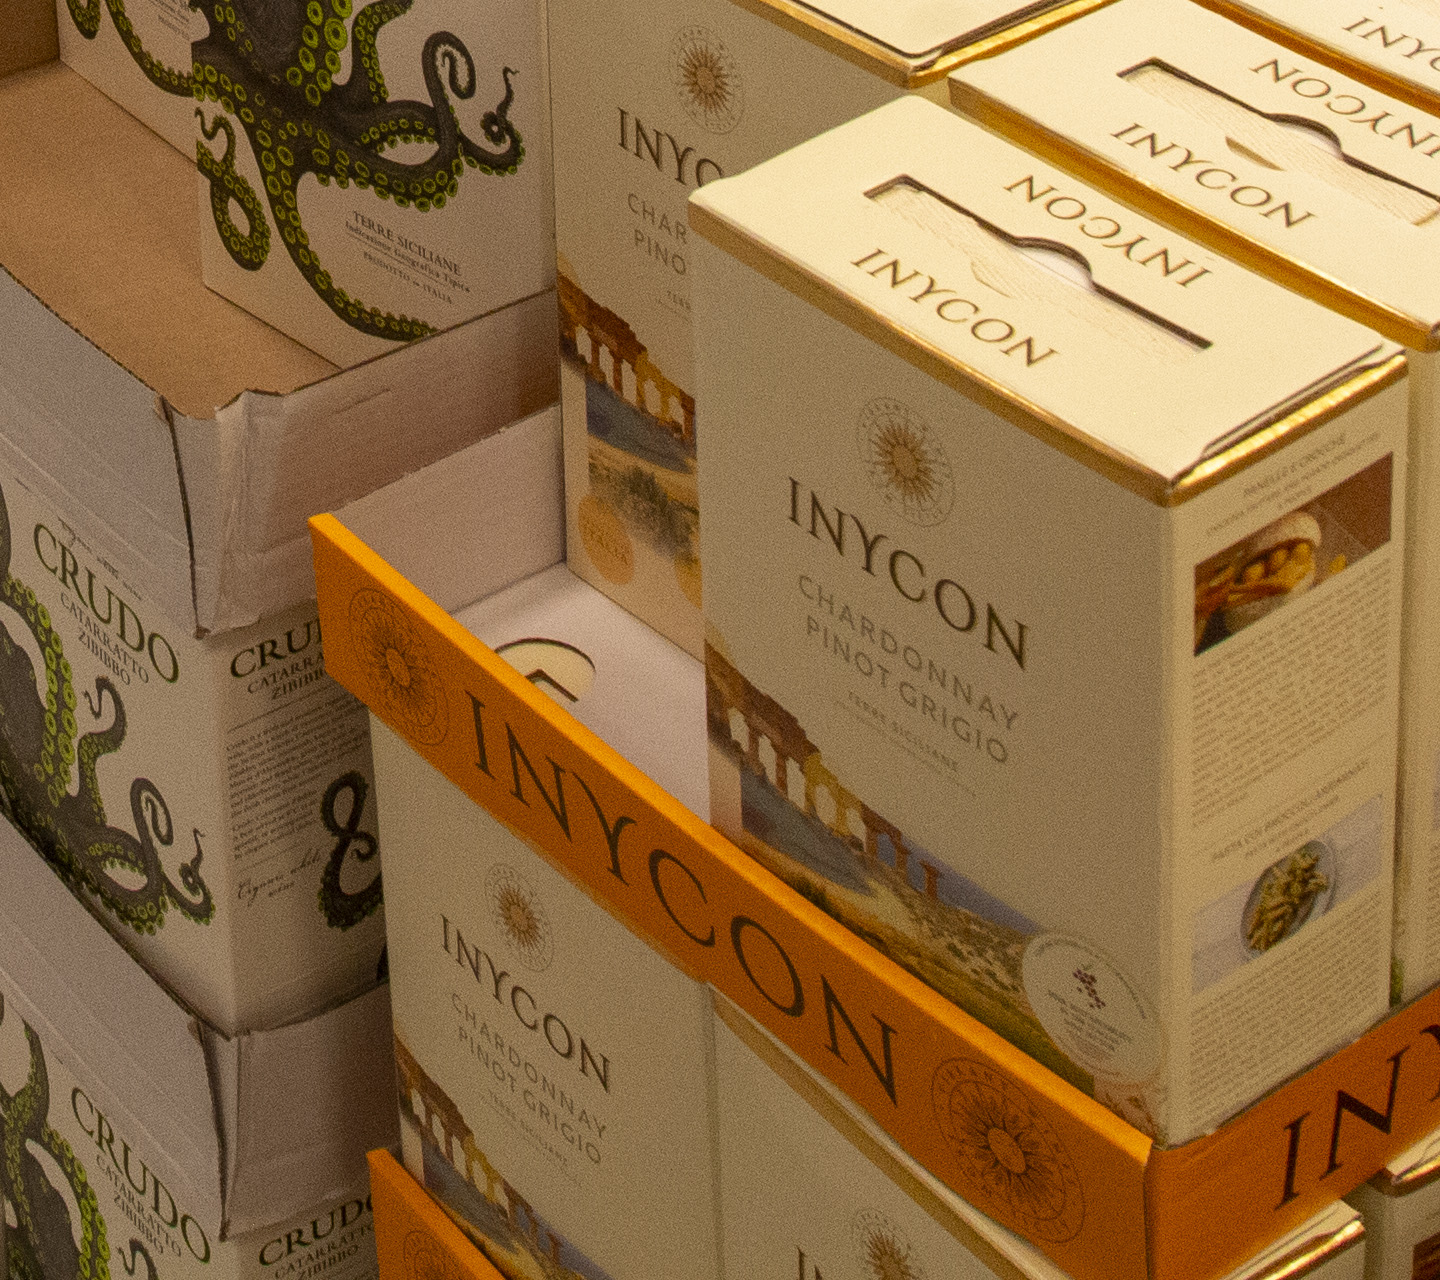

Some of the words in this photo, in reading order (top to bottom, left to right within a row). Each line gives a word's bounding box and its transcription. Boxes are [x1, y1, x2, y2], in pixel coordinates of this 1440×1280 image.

[353, 210, 394, 242] TERRE
[397, 234, 462, 277] SICILIANE
[1003, 173, 1214, 289] INYCON
[1108, 121, 1319, 229] INYCON
[848, 246, 1063, 370] INYCON
[33, 522, 181, 684] CRUDO
[59, 590, 150, 684] CATARRATTO
[787, 474, 1029, 671] INYCON
[77, 628, 131, 687] ZIBIBBO
[798, 573, 1022, 732] CHARDONNAY
[807, 611, 893, 690] PINOT
[897, 678, 1011, 765] GRIGIO
[462, 689, 899, 1110] INYCON
[439, 913, 612, 1096] INYCON
[450, 992, 608, 1141] CHARDONNAY
[455, 1027, 521, 1092] PINOT
[522, 1078, 603, 1167] GRIGIO
[71, 1086, 212, 1266] CRUDO
[96, 1152, 182, 1258] CATARRATTO
[113, 1195, 165, 1257] ZIBIBBO
